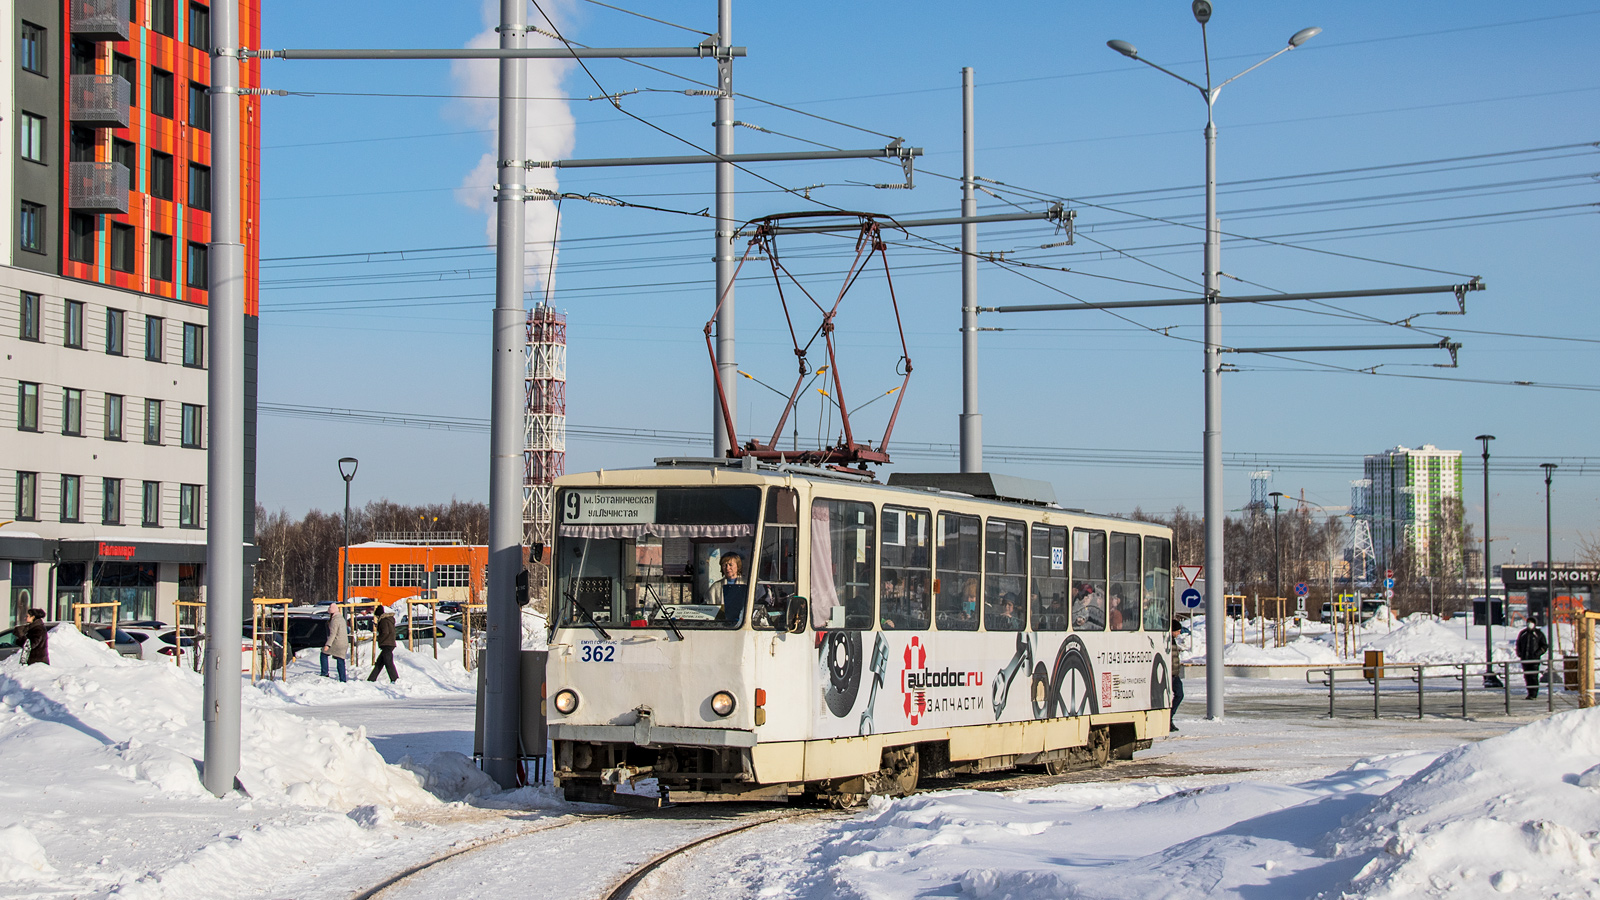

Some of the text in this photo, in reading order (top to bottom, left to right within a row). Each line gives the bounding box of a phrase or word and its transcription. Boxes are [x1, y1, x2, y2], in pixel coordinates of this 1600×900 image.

[566, 492, 581, 520] 9
[1053, 549, 1063, 564] 362
[581, 645, 615, 662] 362
[908, 667, 983, 688] autodoc.ru
[927, 696, 984, 712] ЗАПЧАСТИ
